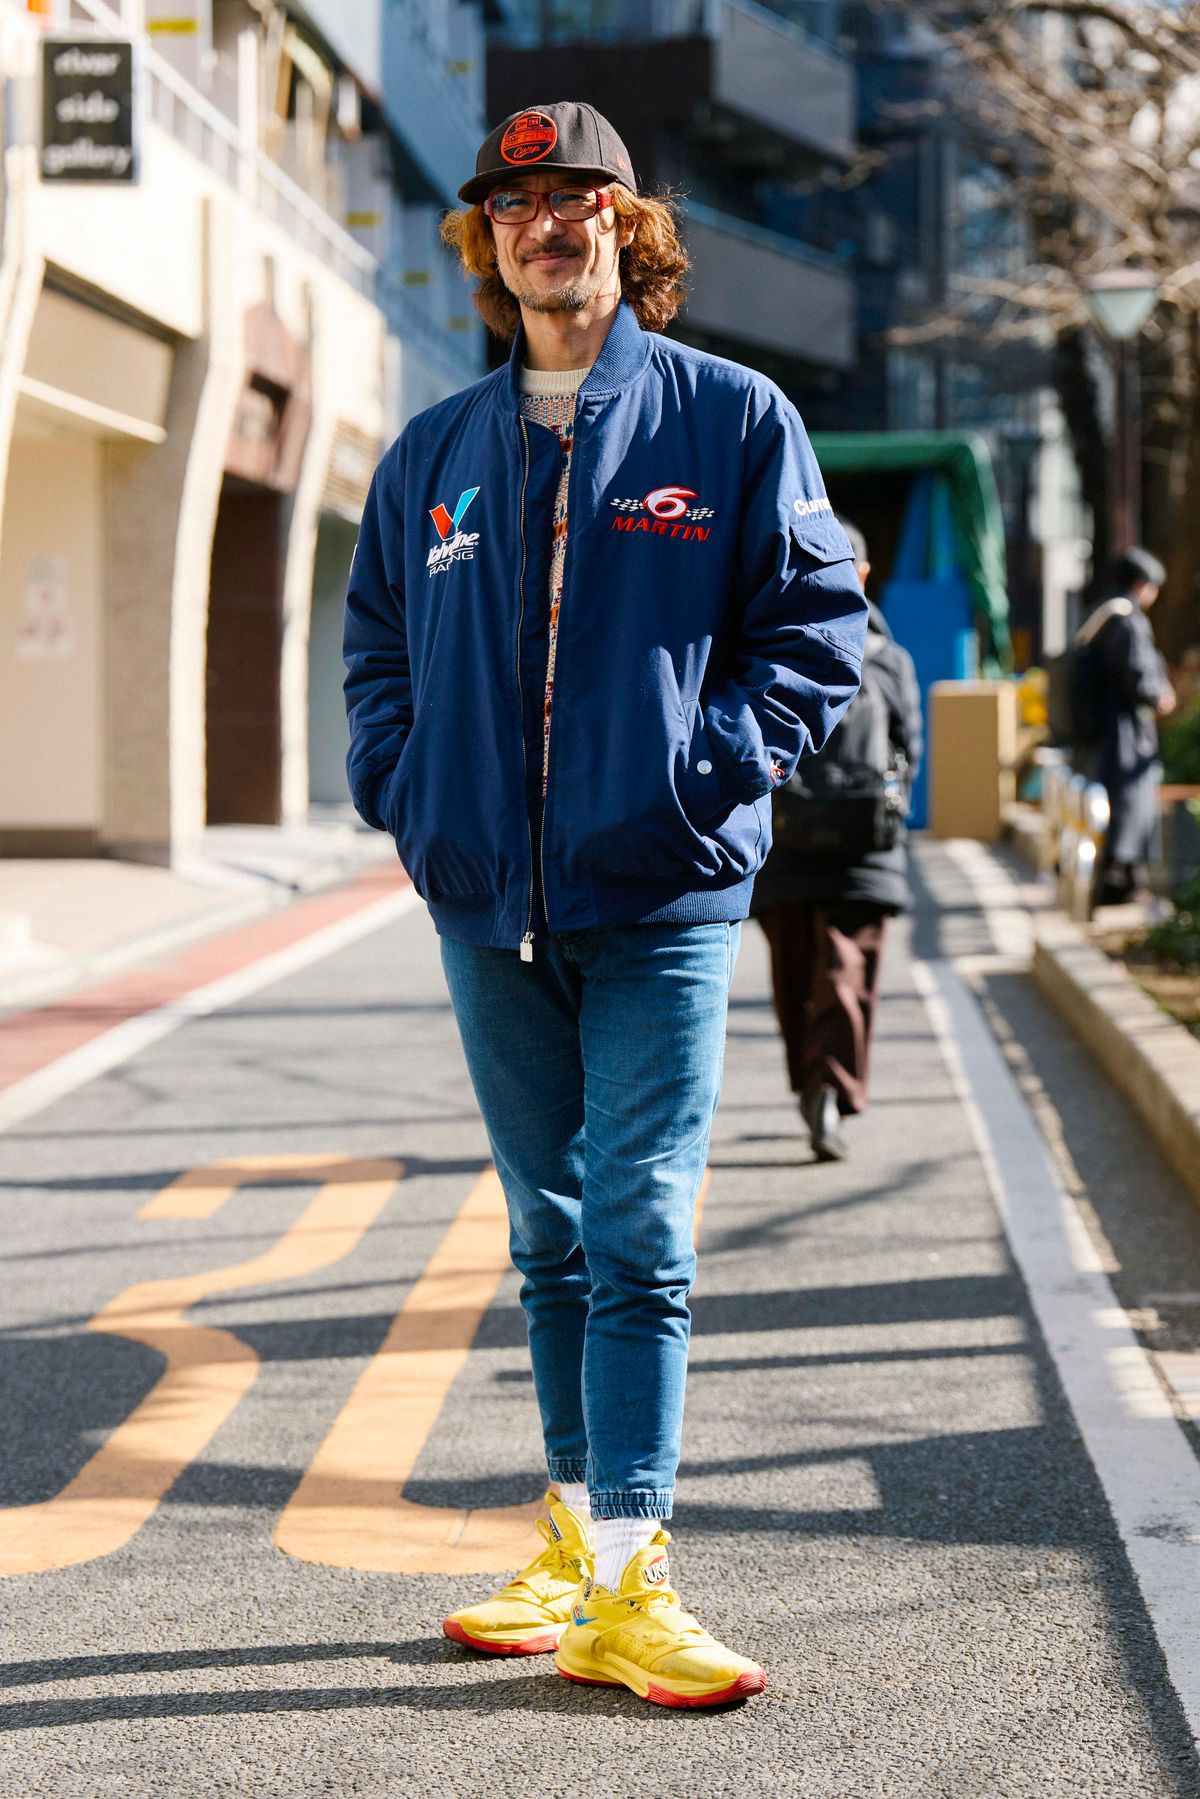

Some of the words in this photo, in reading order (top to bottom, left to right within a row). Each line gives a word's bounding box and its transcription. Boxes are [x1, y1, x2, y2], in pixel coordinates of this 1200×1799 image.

[54, 46, 121, 77] river
[56, 91, 119, 123] side
[43, 137, 131, 174] gallery
[611, 516, 712, 542] MARTIN
